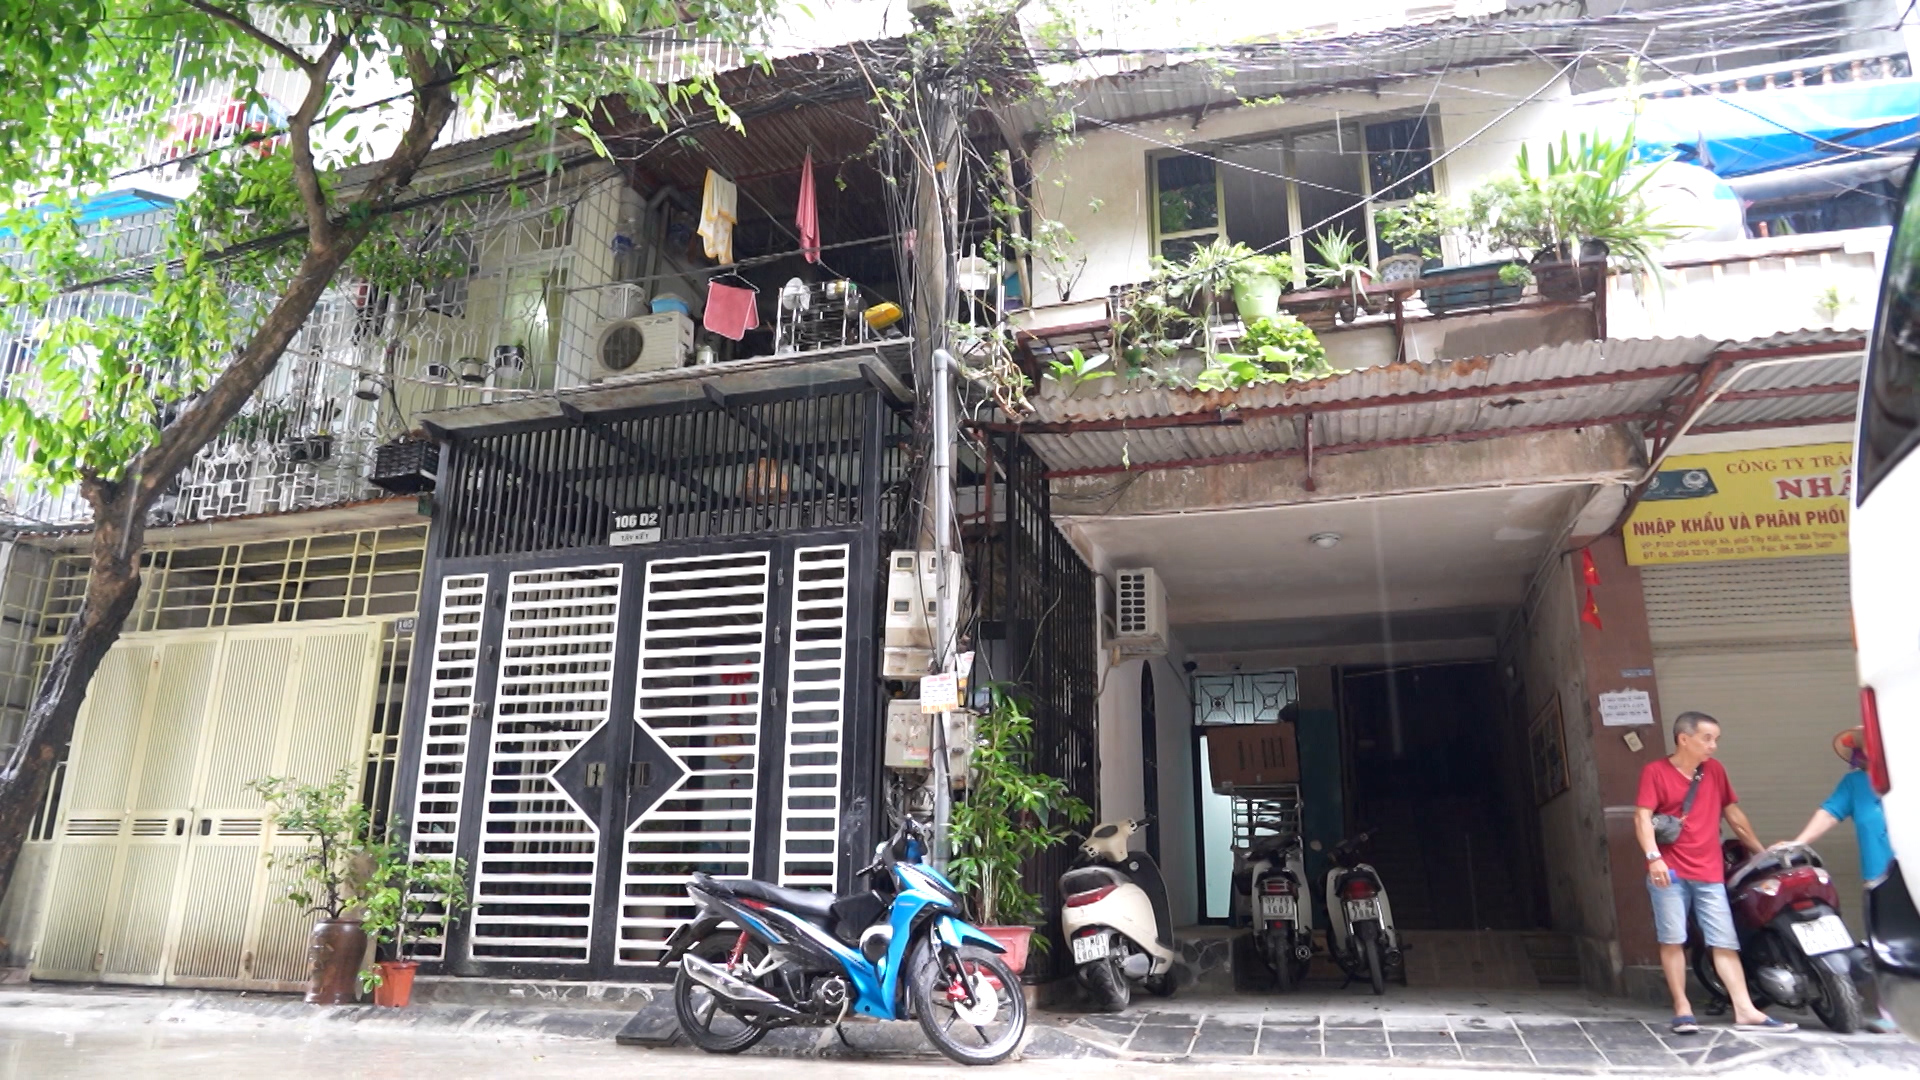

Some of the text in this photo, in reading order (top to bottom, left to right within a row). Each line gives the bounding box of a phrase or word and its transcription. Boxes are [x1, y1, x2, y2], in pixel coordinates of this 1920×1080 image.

[1726, 451, 1852, 474] CÔNG TY TRÁ
[614, 512, 658, 530] 106 D2
[1632, 503, 1847, 538] NHẬP KHẨU VÀ PHÂN PHỐI
